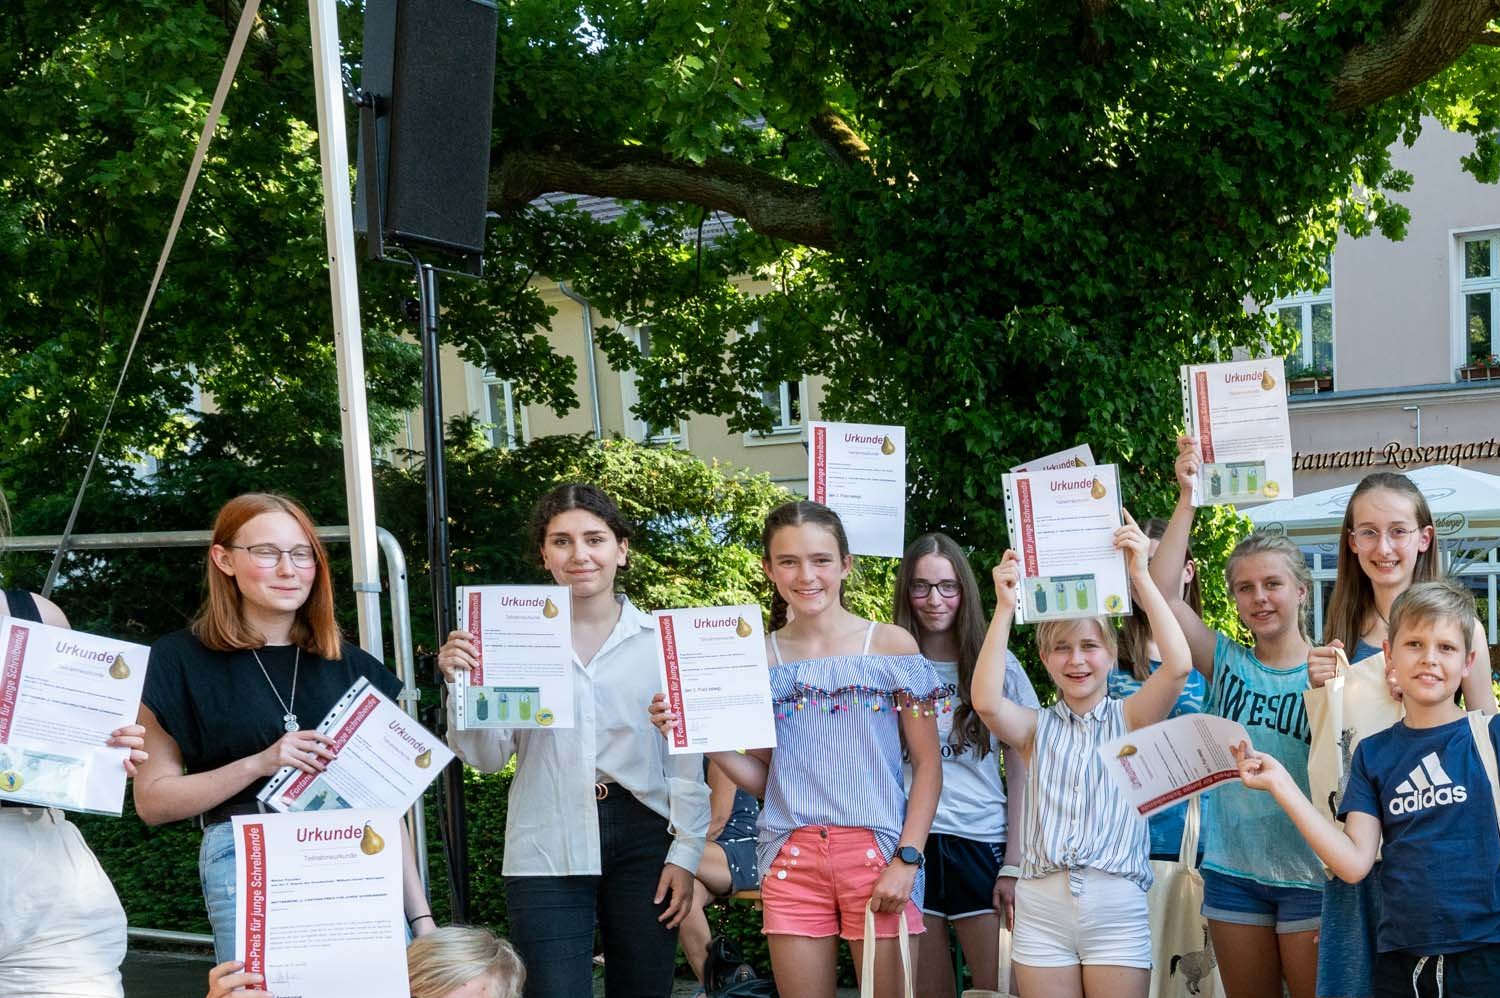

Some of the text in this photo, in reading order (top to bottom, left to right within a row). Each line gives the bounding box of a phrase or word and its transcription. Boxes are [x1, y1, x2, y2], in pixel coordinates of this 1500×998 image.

[1224, 371, 1262, 383] Urkunde
[844, 433, 884, 444] Urkunde
[1050, 478, 1092, 492] Urkunde
[501, 596, 545, 607] Urkunde
[694, 617, 738, 628] Urkunde
[664, 618, 675, 660] Schreibende
[10, 630, 26, 680] Schreibende
[56, 641, 114, 664] Urkunde
[669, 660, 680, 682] junge
[5, 678, 18, 705] junge
[671, 682, 680, 693] für
[345, 698, 378, 737] Schreibende
[388, 720, 426, 754] Urkunde
[1388, 785, 1468, 815] adidas
[296, 826, 362, 842] Urkunde
[250, 828, 262, 888] Schreibende
[252, 890, 264, 918] junge
[250, 918, 262, 932] für
